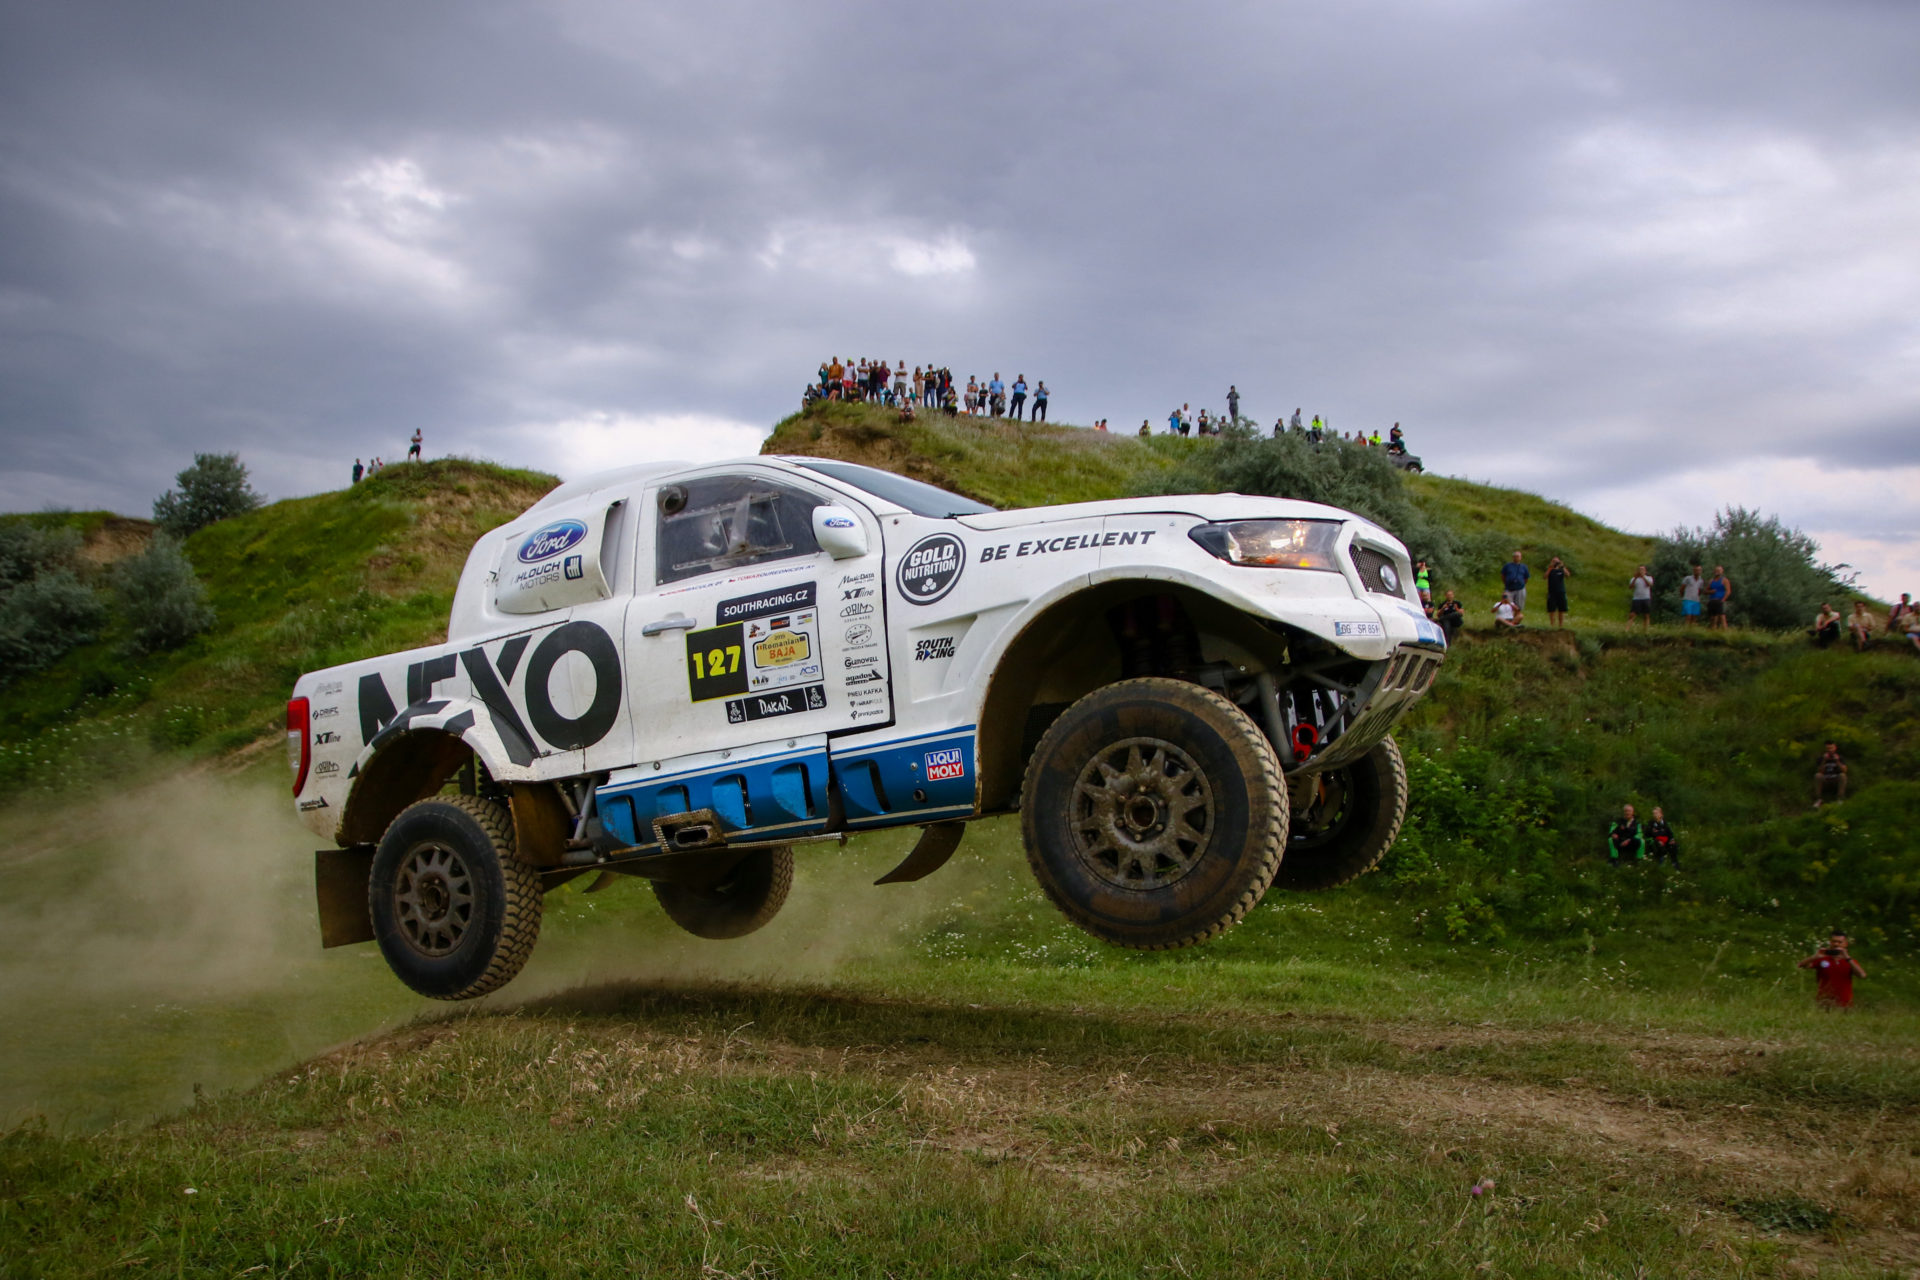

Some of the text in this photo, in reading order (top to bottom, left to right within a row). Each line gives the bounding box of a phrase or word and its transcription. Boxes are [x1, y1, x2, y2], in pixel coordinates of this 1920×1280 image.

[526, 525, 573, 559] Ford
[979, 531, 1156, 563] BE EXCELLENT
[909, 544, 956, 567] GOLD
[516, 561, 561, 583] HLOUCH
[905, 558, 956, 581] NUTRITION
[519, 572, 560, 591] MOTORS
[724, 589, 808, 617] SOUTHRACING.CZ
[762, 638, 800, 650] Romanian
[769, 646, 796, 660] BAJA
[916, 637, 954, 651] SOUTH
[692, 645, 741, 679] 127
[863, 687, 883, 695] KAFKA
[758, 695, 792, 715] DAKAR
[927, 751, 959, 766] LIQUI
[929, 763, 961, 779] MOLY
